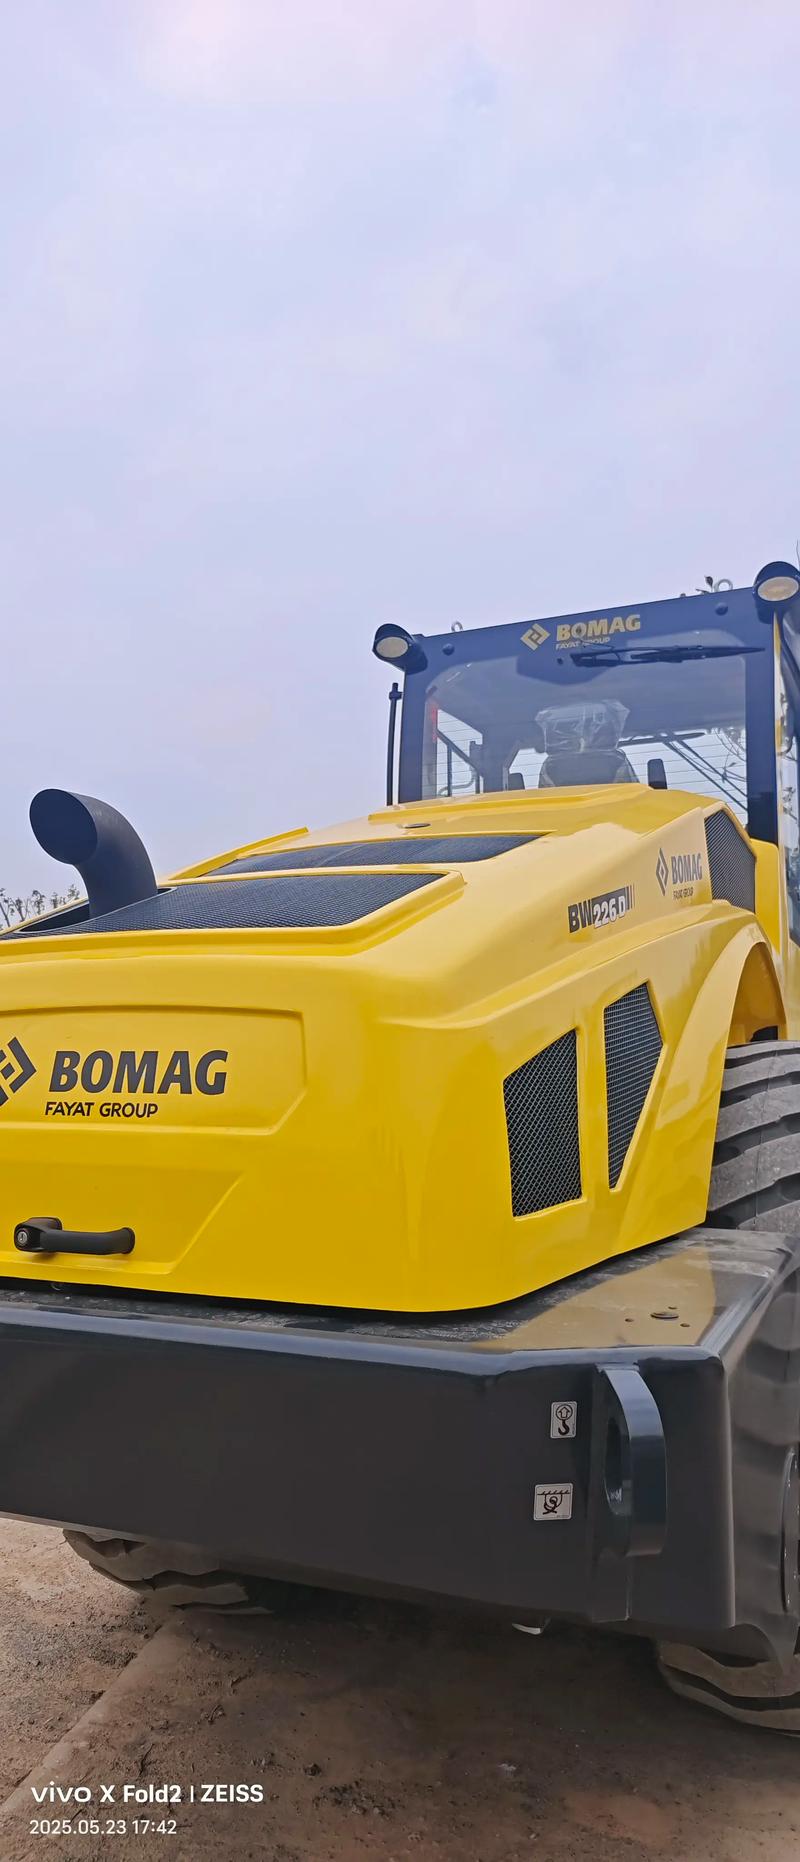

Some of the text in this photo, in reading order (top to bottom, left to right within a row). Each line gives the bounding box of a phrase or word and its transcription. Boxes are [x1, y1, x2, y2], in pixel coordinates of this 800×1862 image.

[557, 614, 640, 641] BOMAG
[671, 853, 703, 885] BOMAG
[49, 1050, 228, 1095] BOMAG
[45, 1102, 158, 1118] FAYAT GROUP
